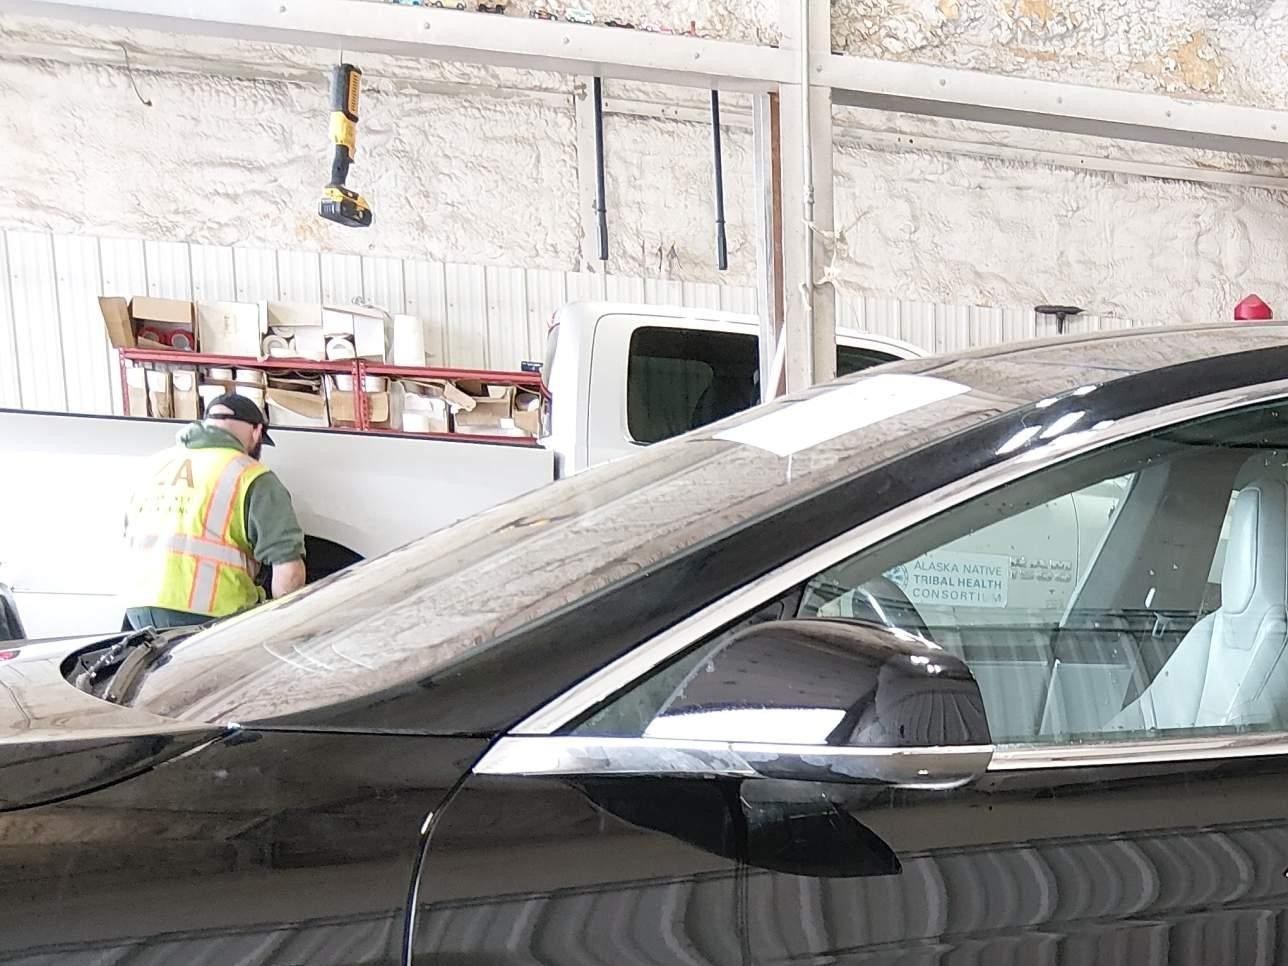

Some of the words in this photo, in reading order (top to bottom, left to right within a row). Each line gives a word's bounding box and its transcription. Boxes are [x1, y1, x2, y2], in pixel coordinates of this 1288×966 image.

[914, 561, 958, 574] ALASKA
[962, 565, 1001, 577] NATIVE
[914, 574, 954, 588] TRIBAL
[958, 577, 1002, 589] HEALTH
